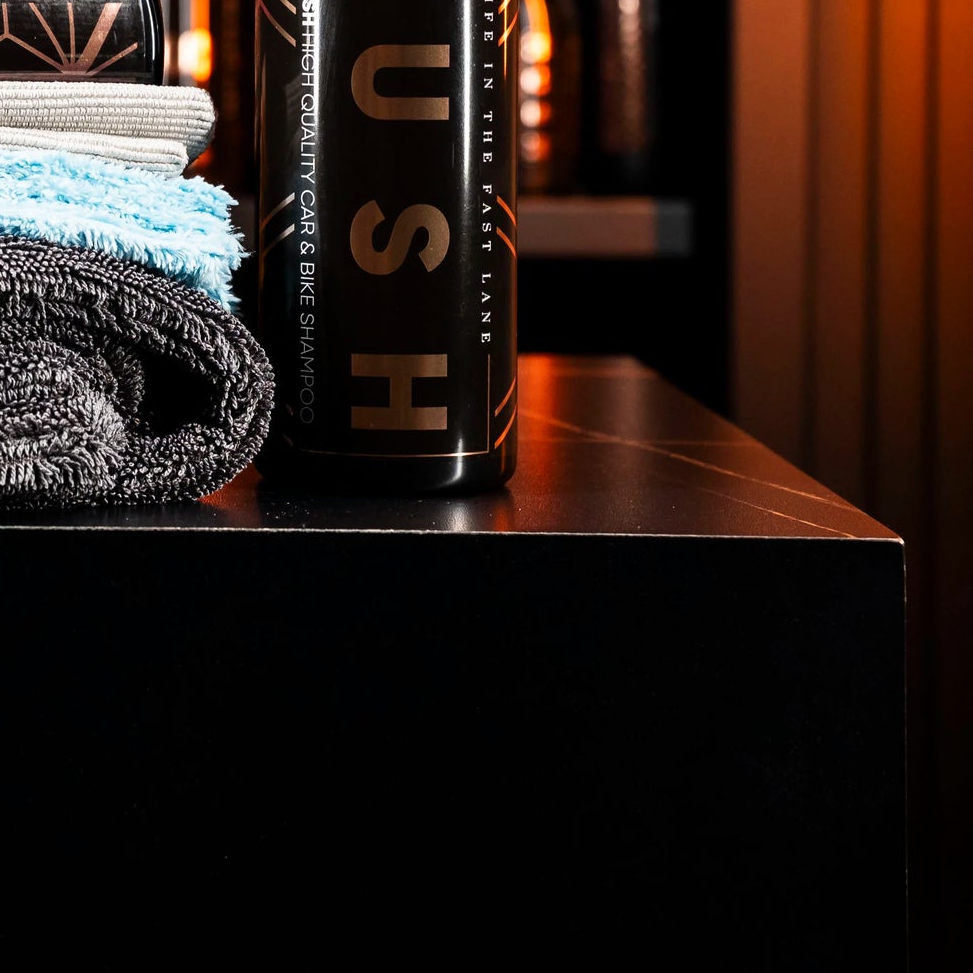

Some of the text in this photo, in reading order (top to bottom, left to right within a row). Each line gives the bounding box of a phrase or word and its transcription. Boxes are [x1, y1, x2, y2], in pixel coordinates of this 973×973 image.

[301, 33, 318, 86] HIGH
[483, 63, 494, 90] IN
[300, 93, 317, 184] QUALITY
[482, 110, 493, 163] THE
[300, 189, 316, 235] CAR
[482, 184, 492, 252] FAST
[300, 241, 315, 255] &
[300, 262, 315, 307] BIKE
[481, 273, 491, 343] LANE
[299, 313, 315, 425] SHAMPOO
